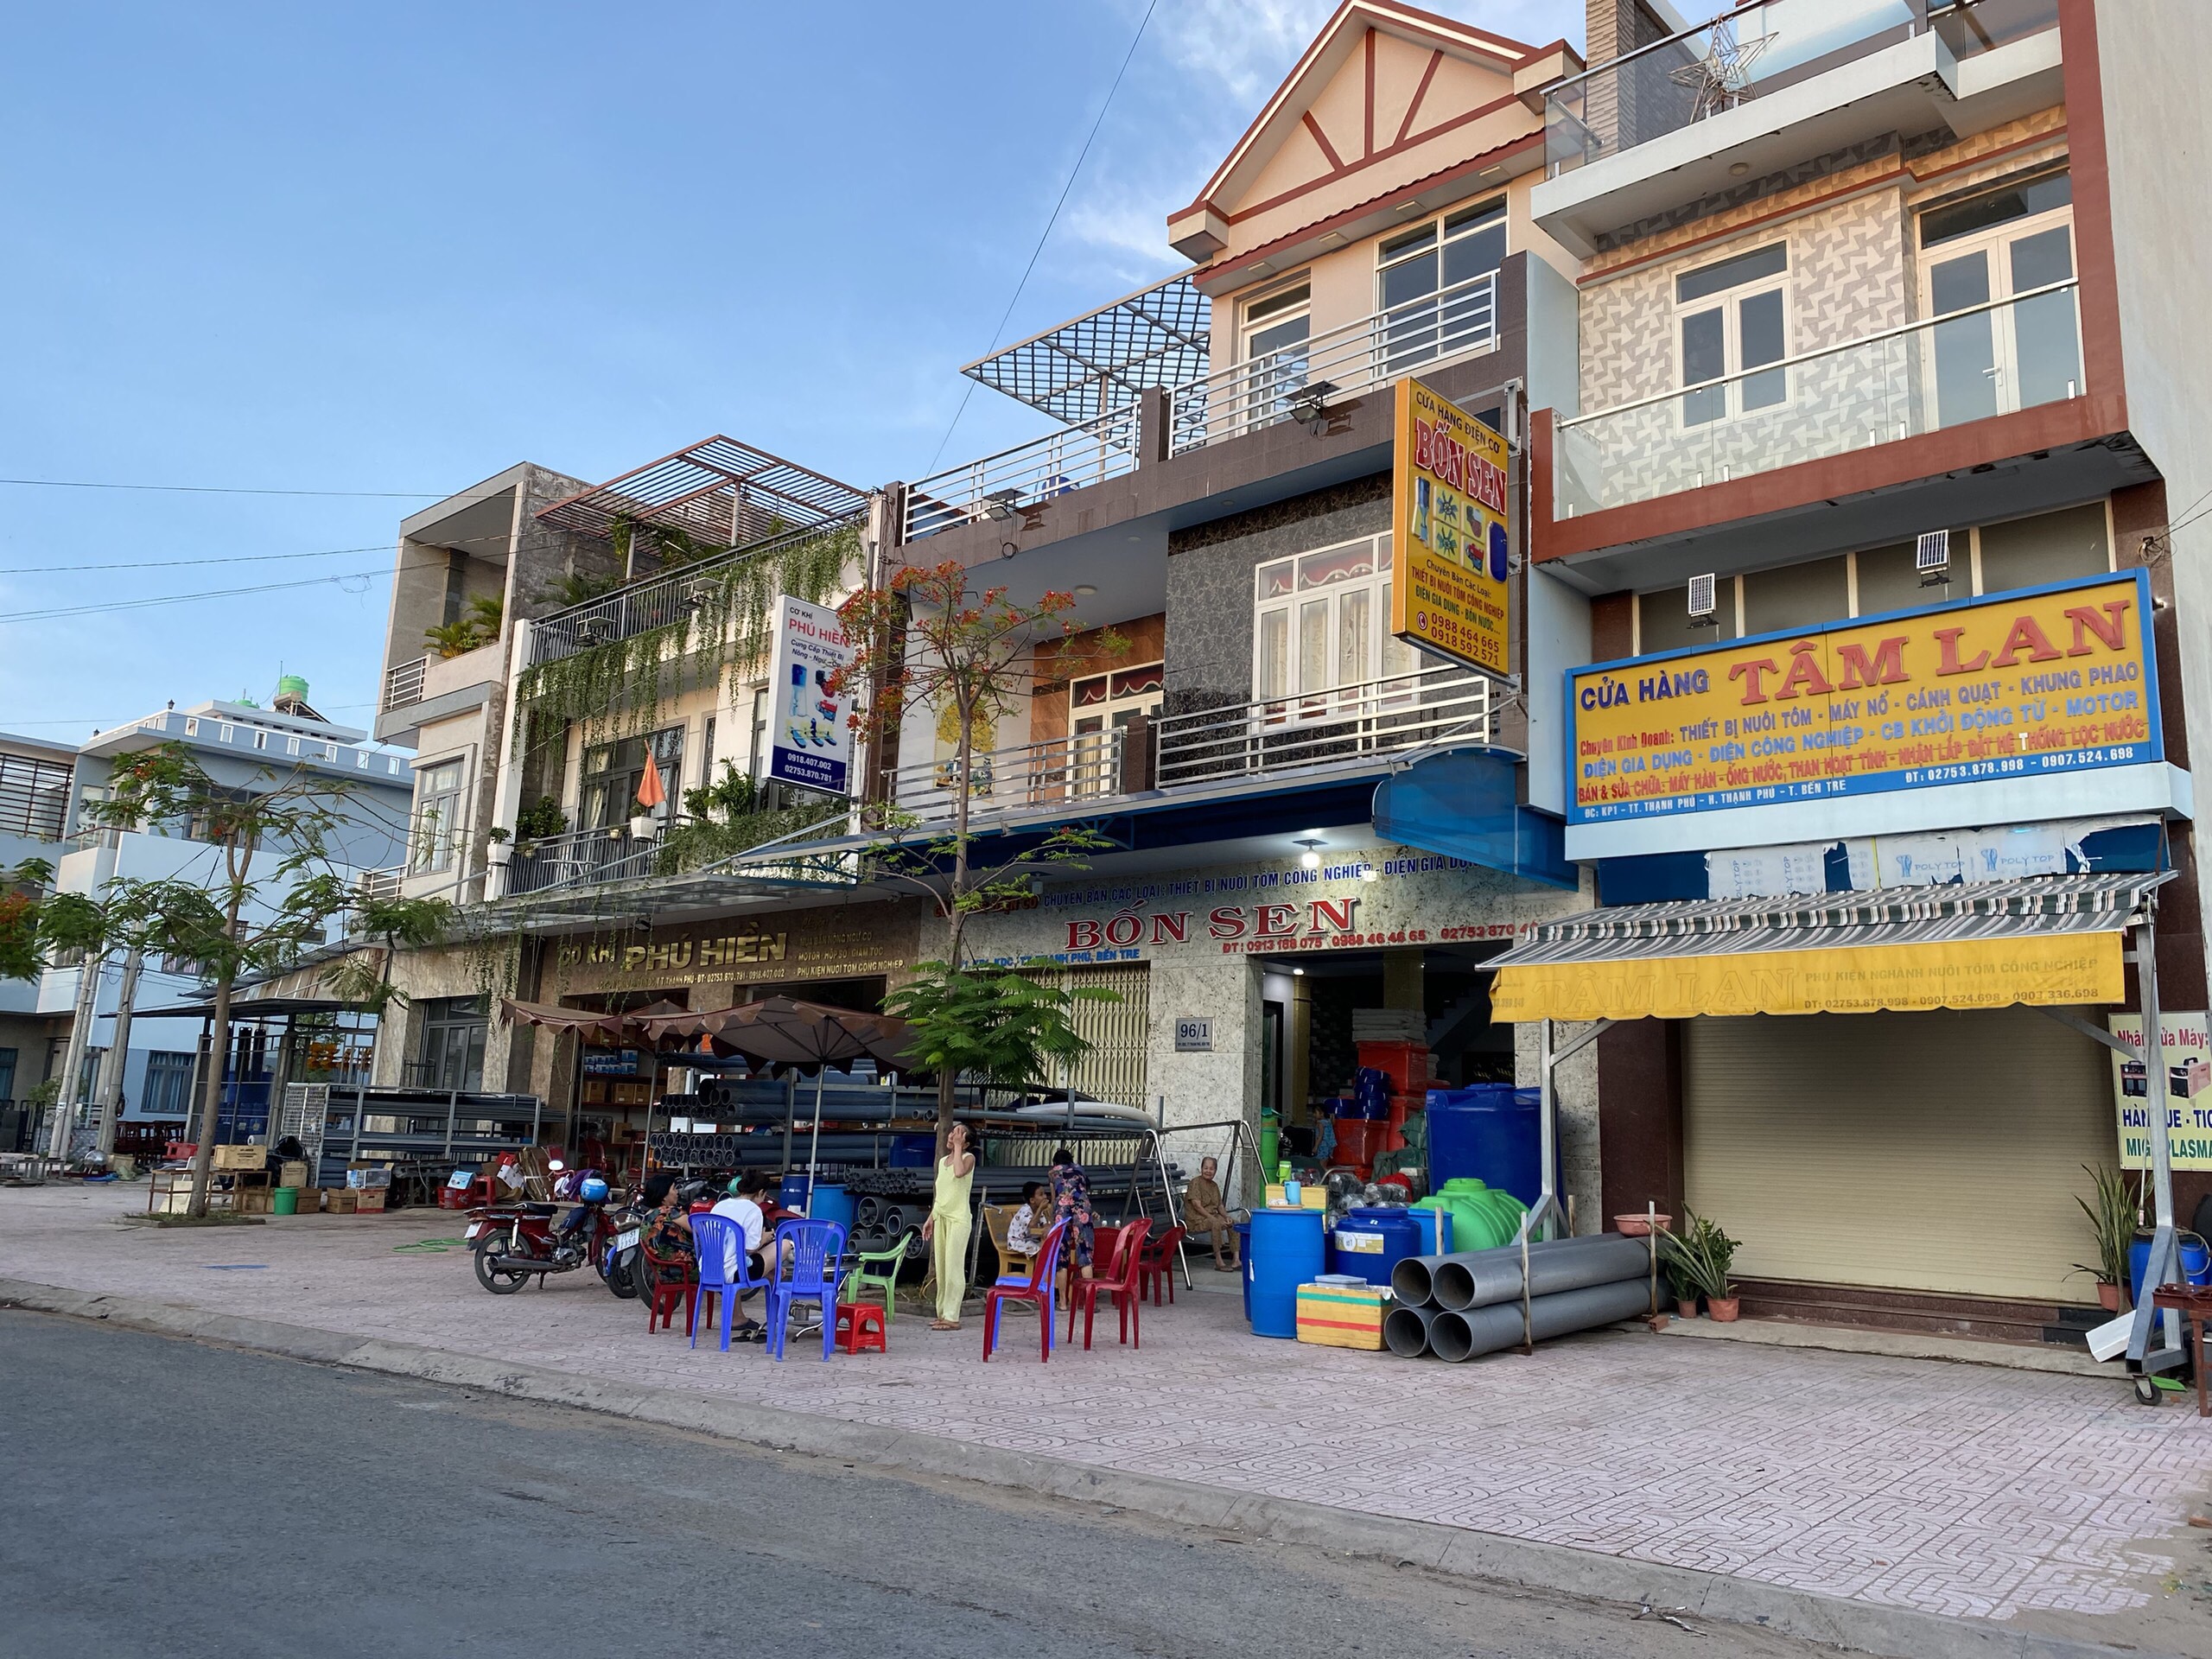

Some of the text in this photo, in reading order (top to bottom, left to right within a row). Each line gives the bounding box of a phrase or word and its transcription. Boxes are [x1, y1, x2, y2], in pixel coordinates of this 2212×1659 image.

[1438, 404, 1463, 431] HÀNG
[1465, 423, 1486, 447] ĐIỆN
[1488, 438, 1501, 454] CƠ
[1414, 417, 1508, 517] BỐN SEN
[1427, 559, 1450, 577] Chuyên
[790, 607, 800, 615] CƠ
[1432, 593, 1442, 608] GIA
[1467, 592, 1483, 612] CÔNG
[789, 618, 816, 637] PHÚ
[791, 639, 807, 650] Cung
[1431, 613, 1499, 653] 0988 464 665
[1431, 626, 1500, 666] 0918 592 571
[1580, 600, 2130, 712] CỬA HÀNG TÂM LAN
[1580, 662, 2139, 757] Chuyên Kinh Doanh: THIẾT BỊ NUÔI TÔM MÁY NỔ CÁNH QUẠT KHUNG PHAO
[1584, 753, 1617, 779] ĐIỆN
[1622, 755, 1646, 774] GIA
[1652, 749, 1693, 772] DỤNG
[1709, 741, 1745, 764] ĐIỆN
[1751, 735, 1796, 757] CÔNG
[1802, 726, 1864, 751] NGHIỆP
[1881, 721, 1905, 741] CB
[1910, 709, 1955, 737] KHỞI
[1960, 706, 2013, 733] ĐỘNG
[2066, 690, 2139, 717] MOTOR
[1578, 782, 1599, 803] BÁN
[1600, 787, 1608, 799] &
[1611, 777, 1630, 798] SỬA
[1669, 772, 1691, 792] MÁY
[1694, 769, 1716, 790] HÀN
[1789, 759, 1821, 779] THAN
[1824, 753, 1853, 777] HOẠT
[1859, 747, 1888, 770] TÍNH
[1898, 741, 1933, 767] NHẬN
[2018, 726, 2067, 752] THỐNG
[2071, 725, 2099, 748] LỌC
[1584, 809, 1599, 818] ĐC:
[1601, 804, 1618, 817] KP1
[1628, 802, 1642, 814] TT.
[1644, 798, 1673, 813] THẠNH
[1677, 794, 1696, 809] PHÚ
[1708, 793, 1719, 805] H.
[1721, 791, 1753, 805] THẠNH
[1756, 784, 1775, 800] PHÚ
[1789, 785, 1798, 797] T.
[1827, 779, 1847, 792] TRE
[1905, 770, 1926, 783] ĐT:
[1928, 758, 2024, 780] 02753.878.998
[2042, 747, 2134, 768] 0907.524.698
[1205, 880, 1217, 897] BỊ
[1284, 865, 1318, 886] CÔNG
[1384, 855, 1417, 878] ĐIỆN
[1421, 855, 1445, 872] GIA
[2000, 856, 2030, 867] POLY
[1064, 899, 1194, 950] BỐN
[1208, 897, 1360, 939] SEN
[1246, 939, 1274, 952] 0913
[1300, 937, 1323, 950] 075
[1332, 933, 1364, 948] 0988
[1367, 931, 1384, 944] 46
[1388, 931, 1406, 944] 46
[1408, 929, 1426, 942] 65
[1440, 925, 1485, 940] 02753
[1489, 923, 1516, 937] 870
[624, 933, 693, 972] PHÚ
[700, 921, 787, 968] HIỀN
[1120, 948, 1141, 959] TRE
[1965, 963, 1995, 976] TÔM
[2000, 960, 2039, 973] CÔNG
[1532, 968, 1656, 1015] TÂM
[1675, 969, 1795, 1010] LAN
[1825, 997, 1909, 1008] 02753.878.998
[1180, 1022, 1208, 1040] 96/1
[2178, 1027, 2209, 1050] Máy:
